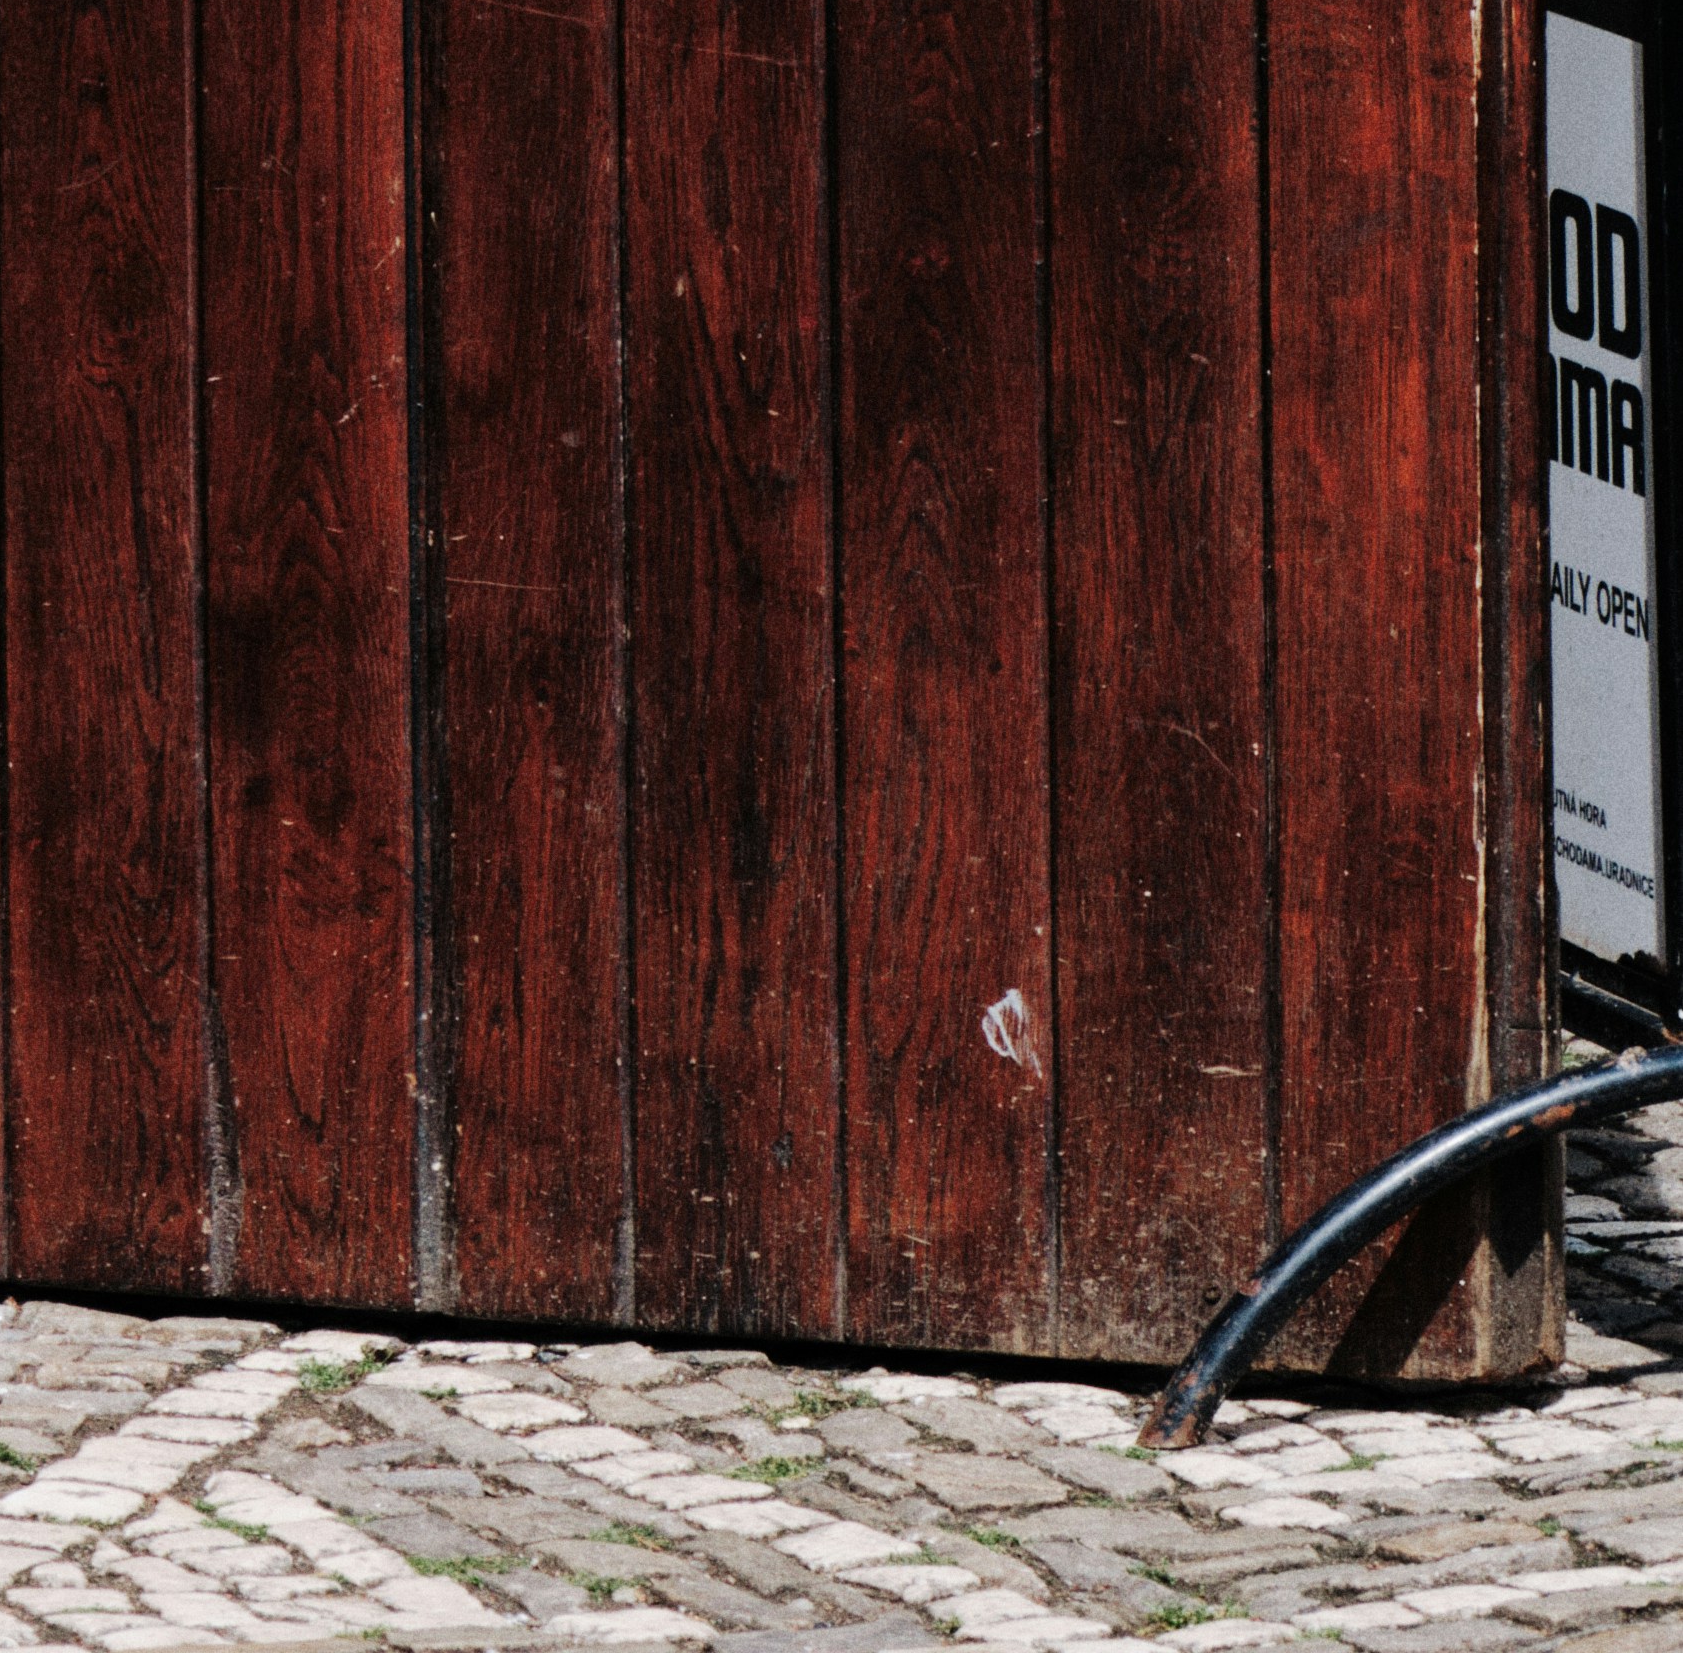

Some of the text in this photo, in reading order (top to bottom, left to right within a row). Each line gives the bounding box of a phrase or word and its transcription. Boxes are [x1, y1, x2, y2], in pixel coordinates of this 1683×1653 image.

[1549, 353, 1645, 498] MA
[1597, 580, 1650, 642] OPEN
[1579, 798, 1608, 830] HORA
[1553, 836, 1655, 900] CHODAMA.URADNICE
